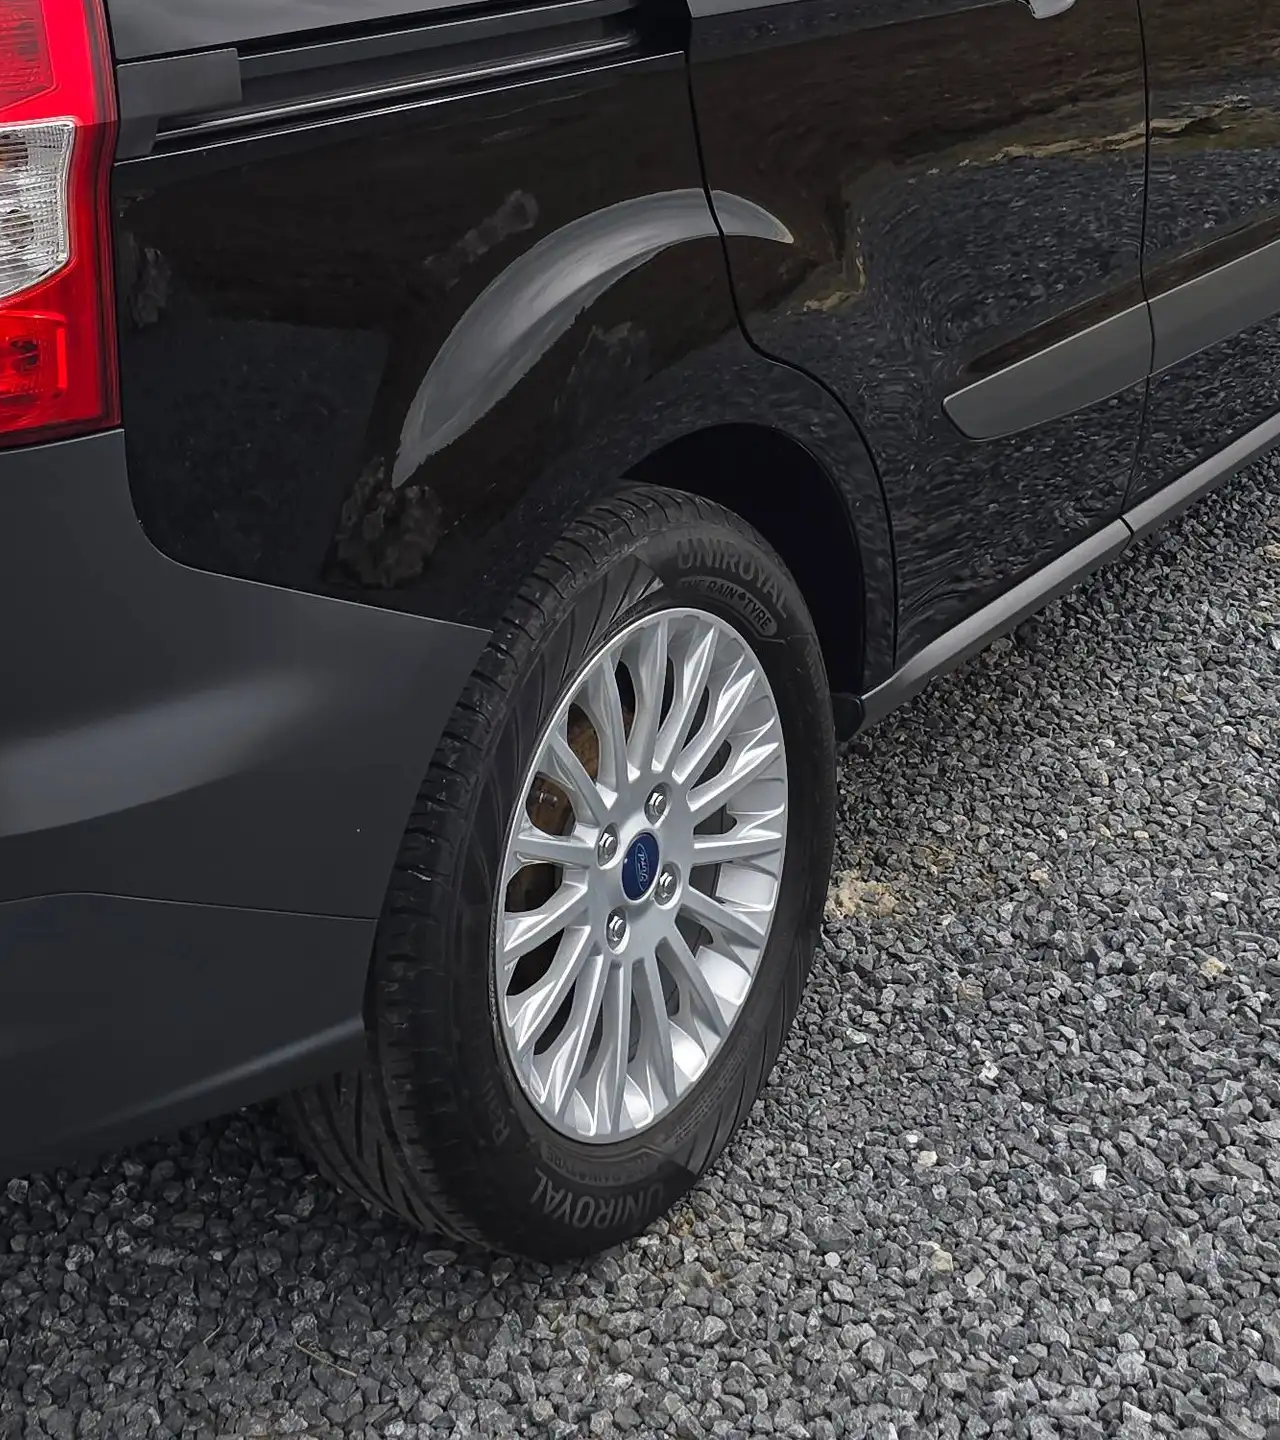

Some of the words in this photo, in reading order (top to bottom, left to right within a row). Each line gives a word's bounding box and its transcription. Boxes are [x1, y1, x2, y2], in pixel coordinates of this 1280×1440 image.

[676, 537, 788, 619] UNIROYAL
[705, 580, 738, 601] RAIN
[742, 596, 773, 631] TYRE
[530, 1165, 665, 1229] UNIROYAL
